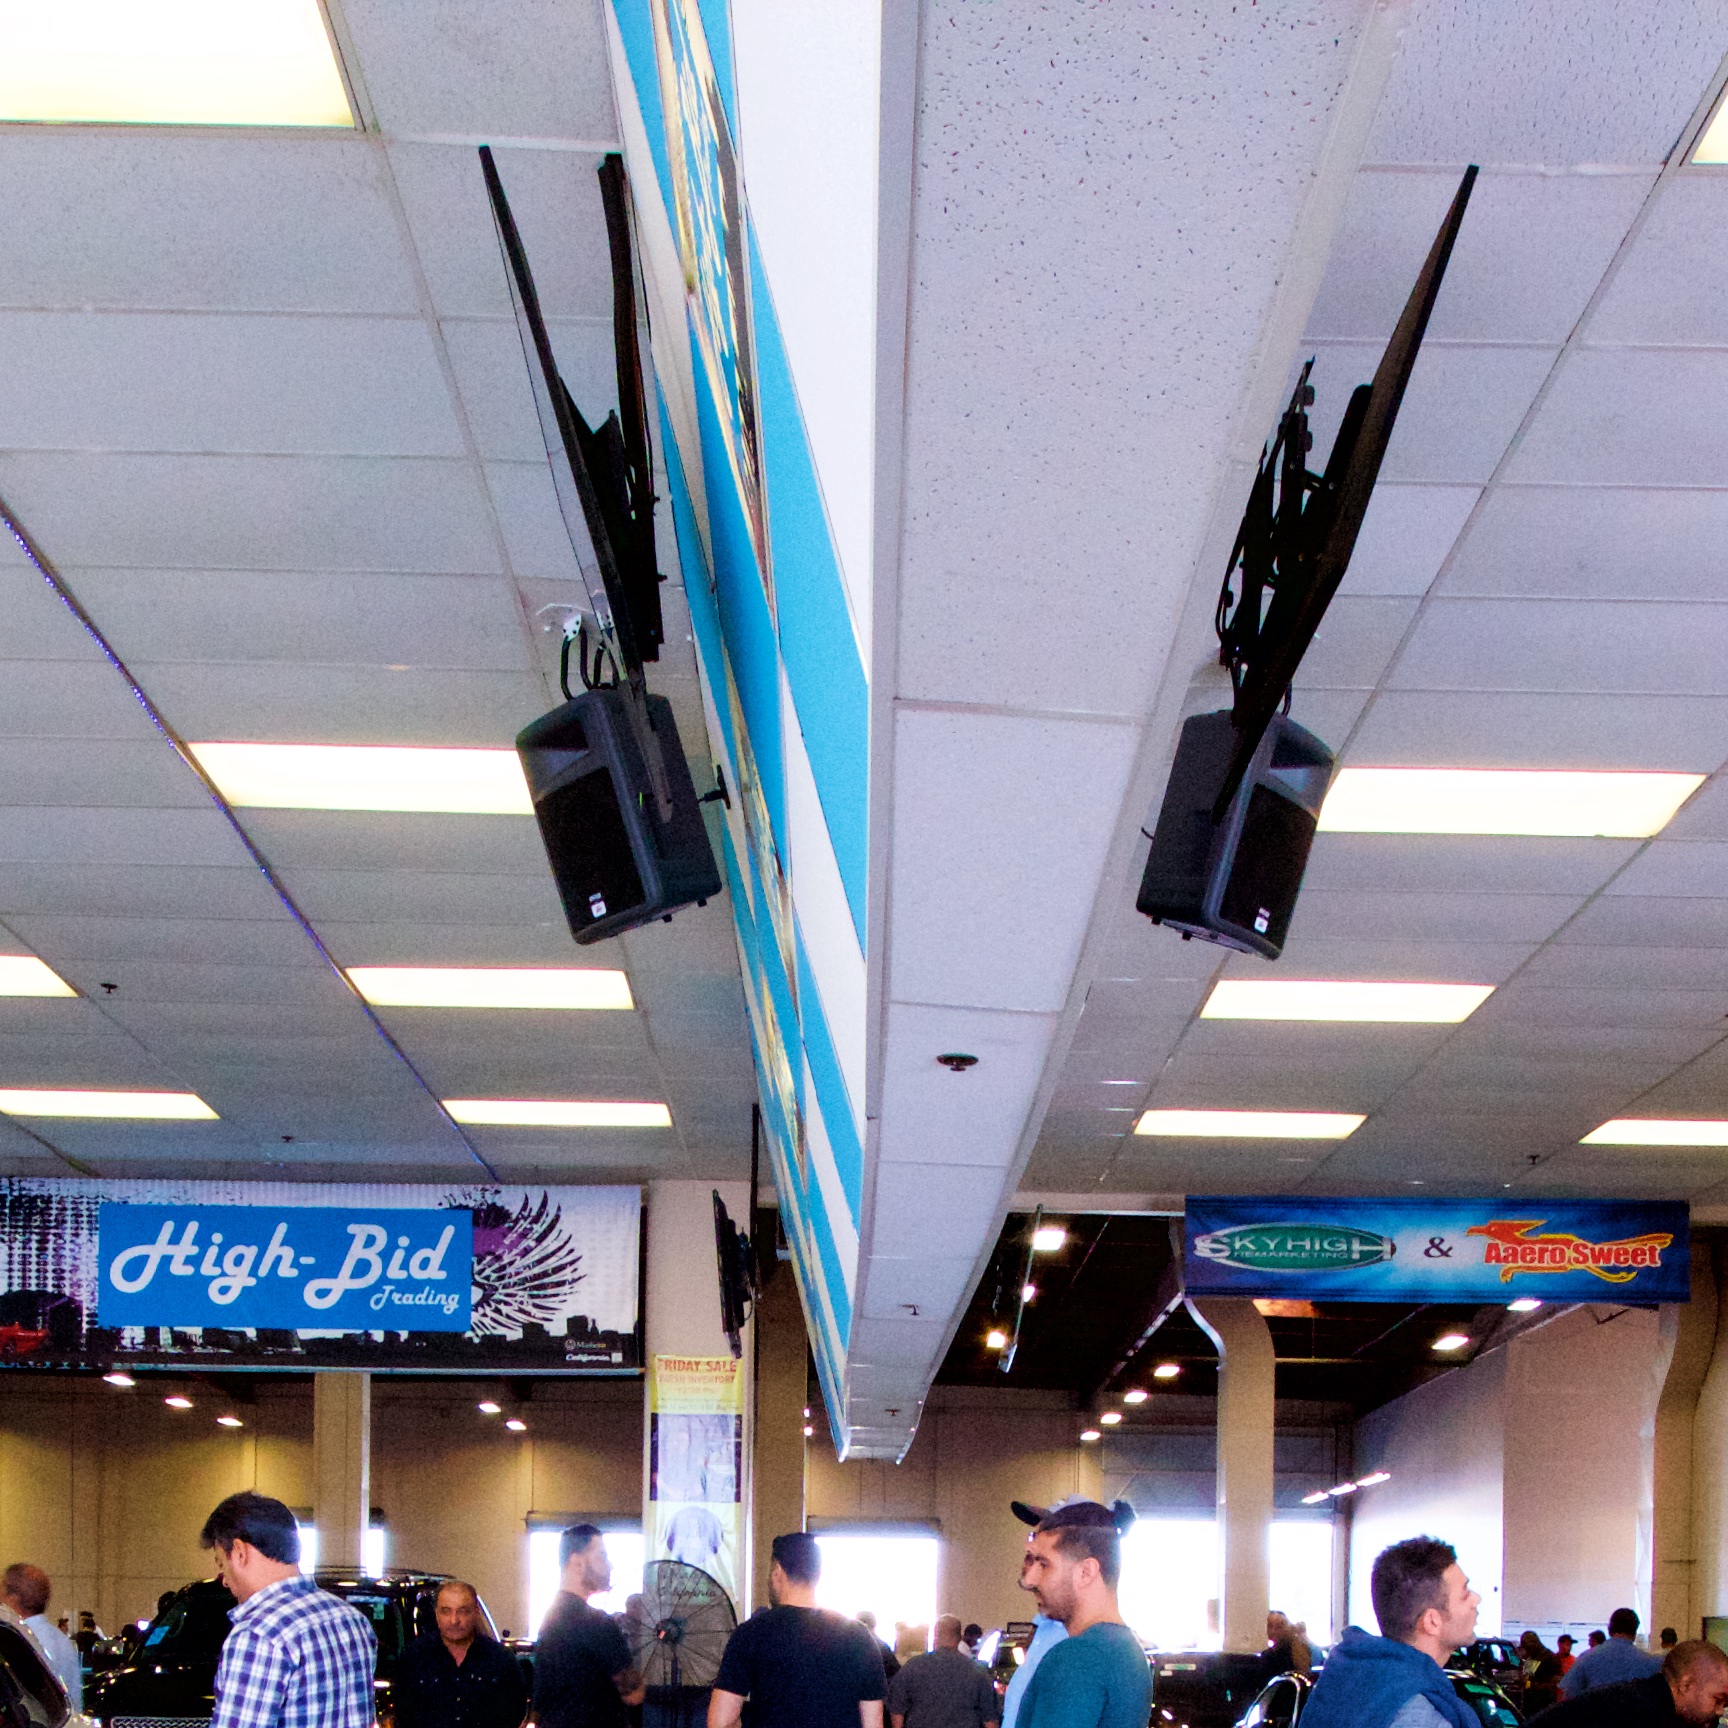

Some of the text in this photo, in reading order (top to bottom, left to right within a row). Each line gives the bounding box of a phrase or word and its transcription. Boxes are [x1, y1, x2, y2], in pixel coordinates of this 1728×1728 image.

[109, 1220, 456, 1310] High-Bid
[1194, 1234, 1662, 1267] SKYHIGH & Aaero Sweet
[369, 1285, 460, 1315] Trading
[657, 1359, 737, 1372] FRIDAY SALE
